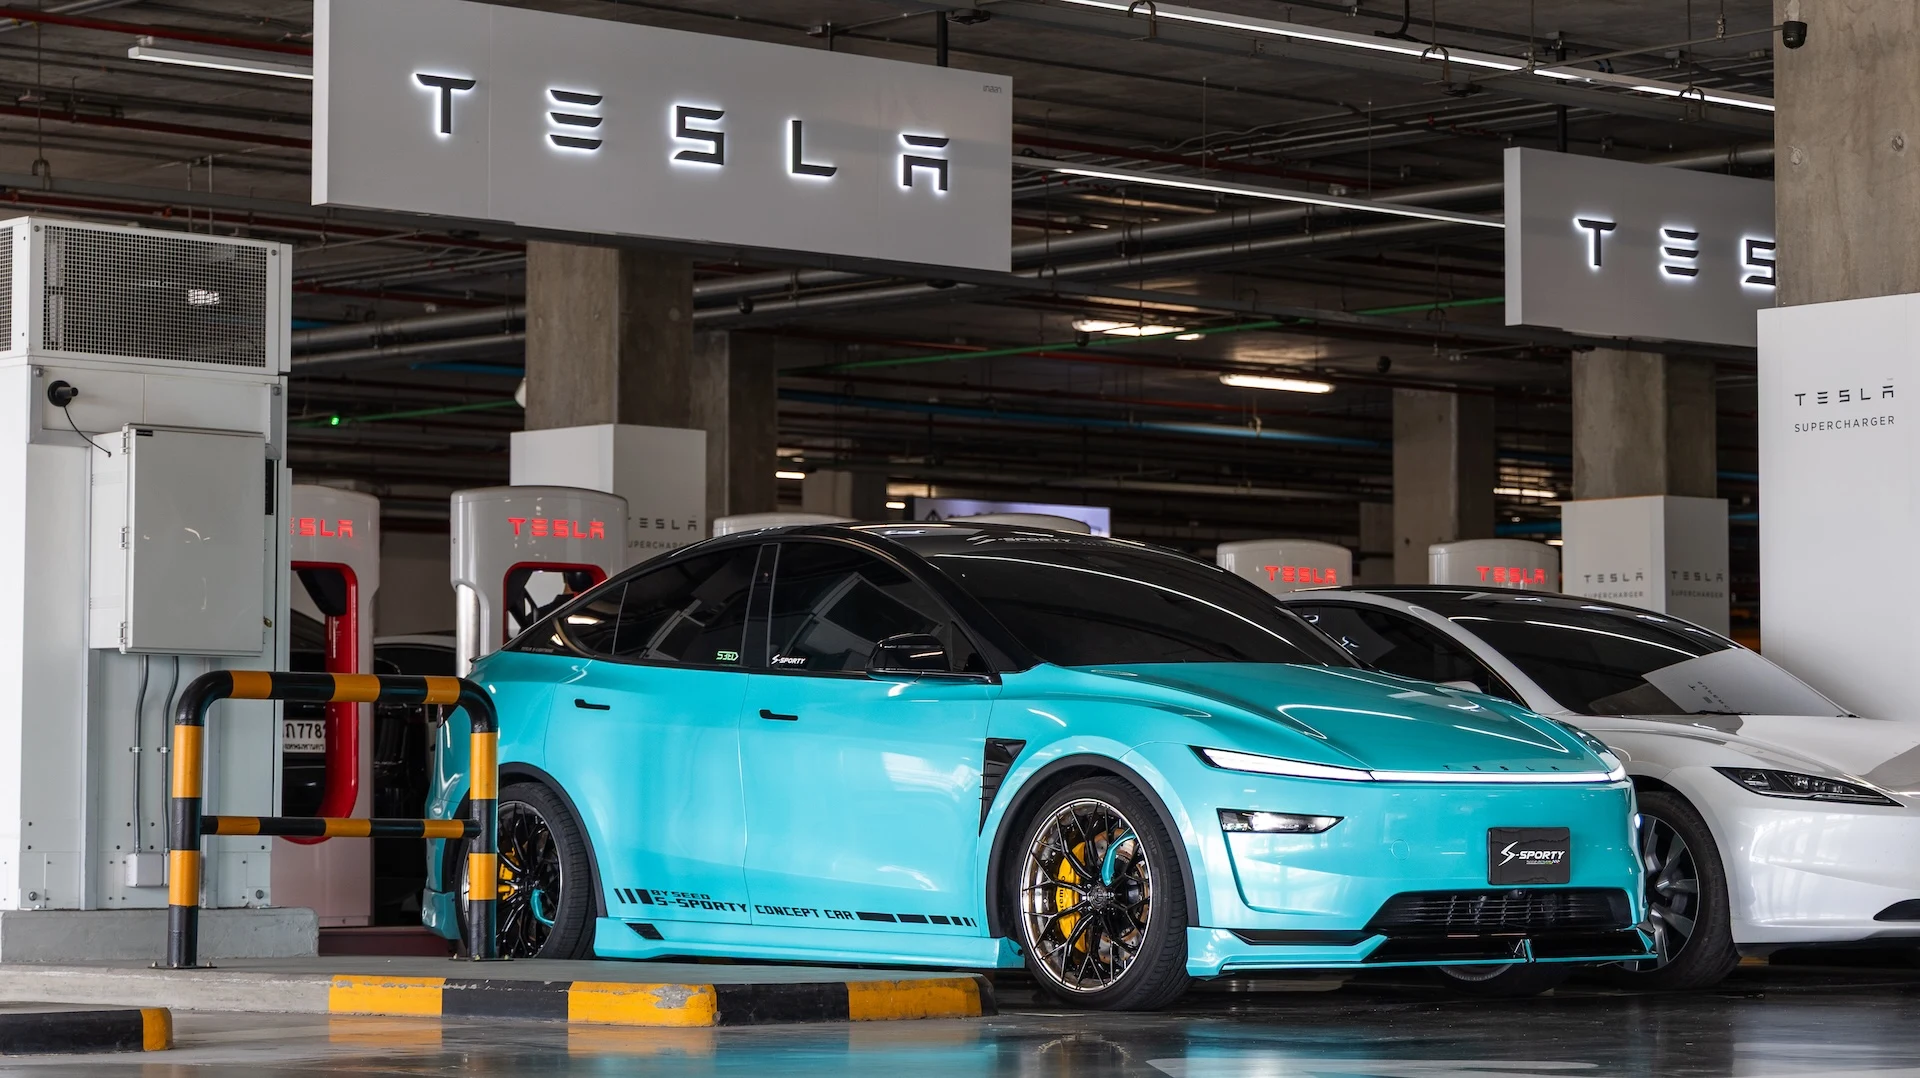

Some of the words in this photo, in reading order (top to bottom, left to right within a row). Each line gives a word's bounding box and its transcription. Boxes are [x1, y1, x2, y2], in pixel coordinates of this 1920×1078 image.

[412, 72, 951, 191] TESLA
[1572, 217, 1775, 287] TES
[1794, 385, 1894, 406] TESLA
[1794, 415, 1895, 432] SUPERCHARGER
[290, 516, 353, 538] ESLA
[508, 517, 604, 539] TESLA
[628, 516, 697, 531] ESLA
[1264, 565, 1337, 584] TESLA
[1476, 565, 1545, 584] TESLA
[1584, 572, 1644, 583] TESLA
[1671, 571, 1724, 582] TESLA
[1671, 589, 1724, 598] SUPERCHARGER
[771, 654, 806, 664] S-SPORTY
[283, 723, 296, 739] ก
[1498, 841, 1565, 867] S-SPORTY
[650, 889, 669, 897] BY
[671, 891, 711, 900] SEED
[654, 896, 748, 913] S-SPORTY
[754, 904, 820, 919] CONCEPT
[823, 909, 855, 921] CAR
